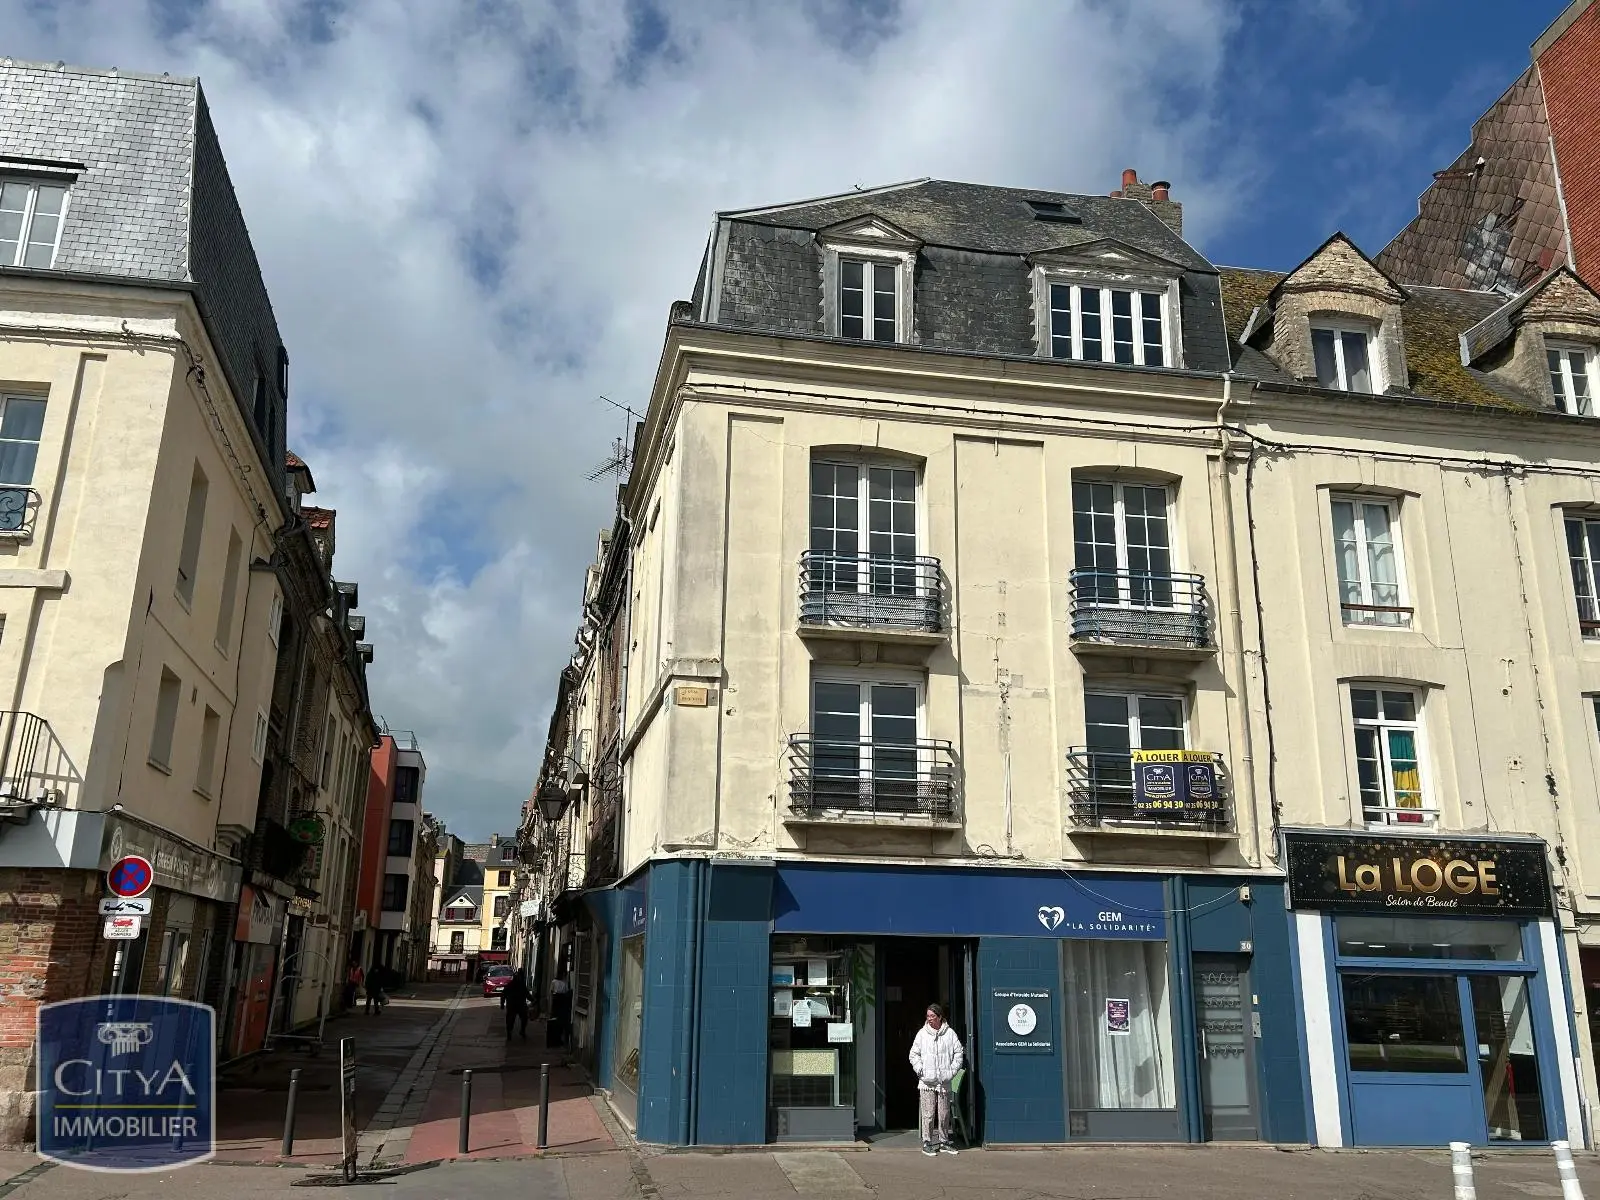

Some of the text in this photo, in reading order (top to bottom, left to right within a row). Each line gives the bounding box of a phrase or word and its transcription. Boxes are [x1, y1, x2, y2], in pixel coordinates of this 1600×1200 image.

[1136, 752, 1143, 761] À
[1191, 754, 1212, 762] LOUER
[1152, 800, 1161, 808] 06
[1163, 801, 1172, 809] 94
[1174, 801, 1183, 809] 30
[1337, 855, 1499, 895] La LOGE
[1385, 894, 1458, 908] Salon de Beauté
[1098, 911, 1122, 922] GEM
